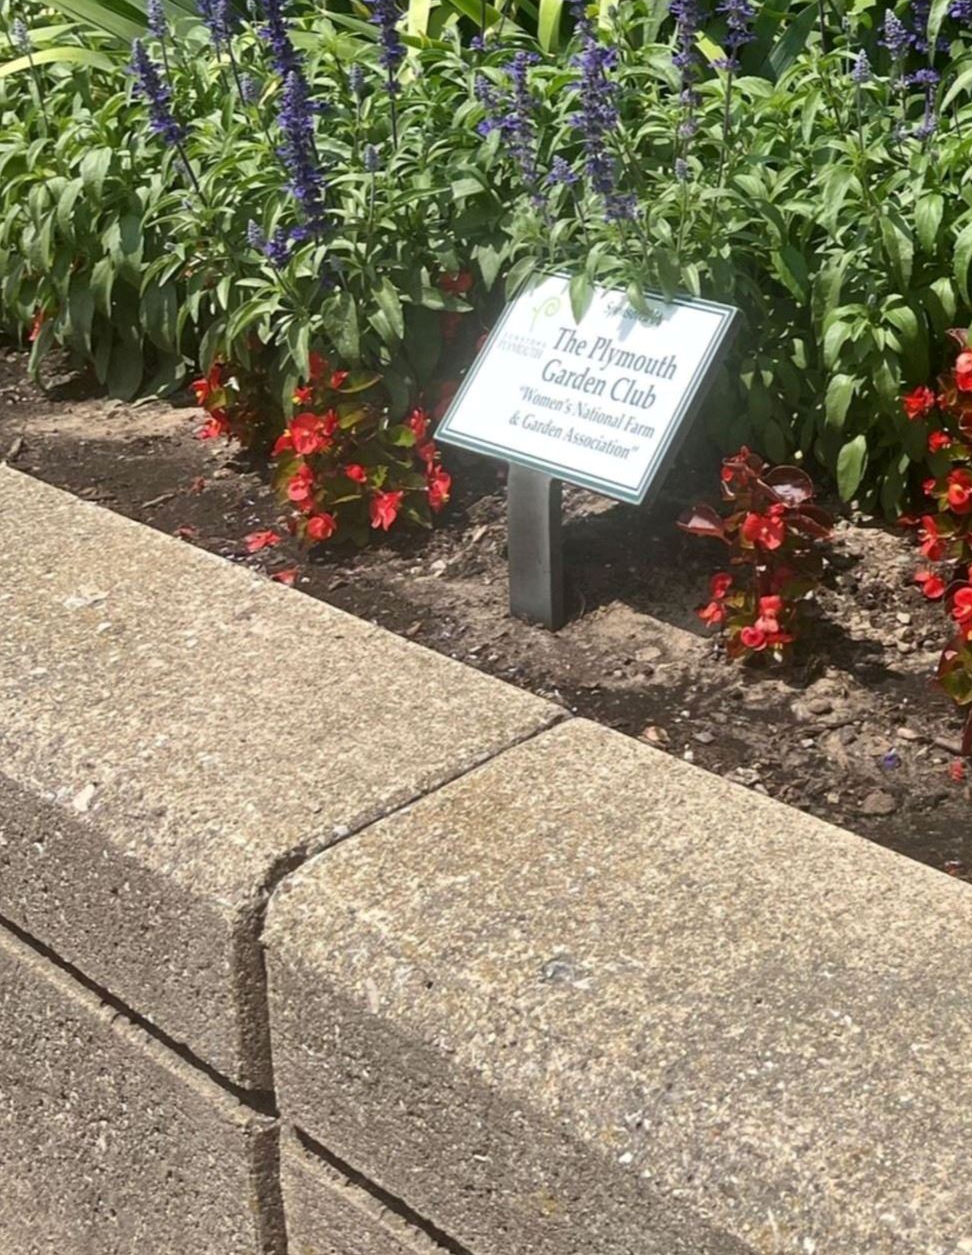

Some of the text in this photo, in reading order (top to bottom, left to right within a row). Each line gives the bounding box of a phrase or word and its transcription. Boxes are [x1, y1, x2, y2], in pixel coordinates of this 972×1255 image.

[553, 326, 678, 380] The Plymouth
[541, 358, 656, 410] Garden Club
[508, 411, 521, 426] &
[521, 413, 564, 439] Garden
[573, 401, 625, 430] National
[624, 416, 656, 440] Farm
